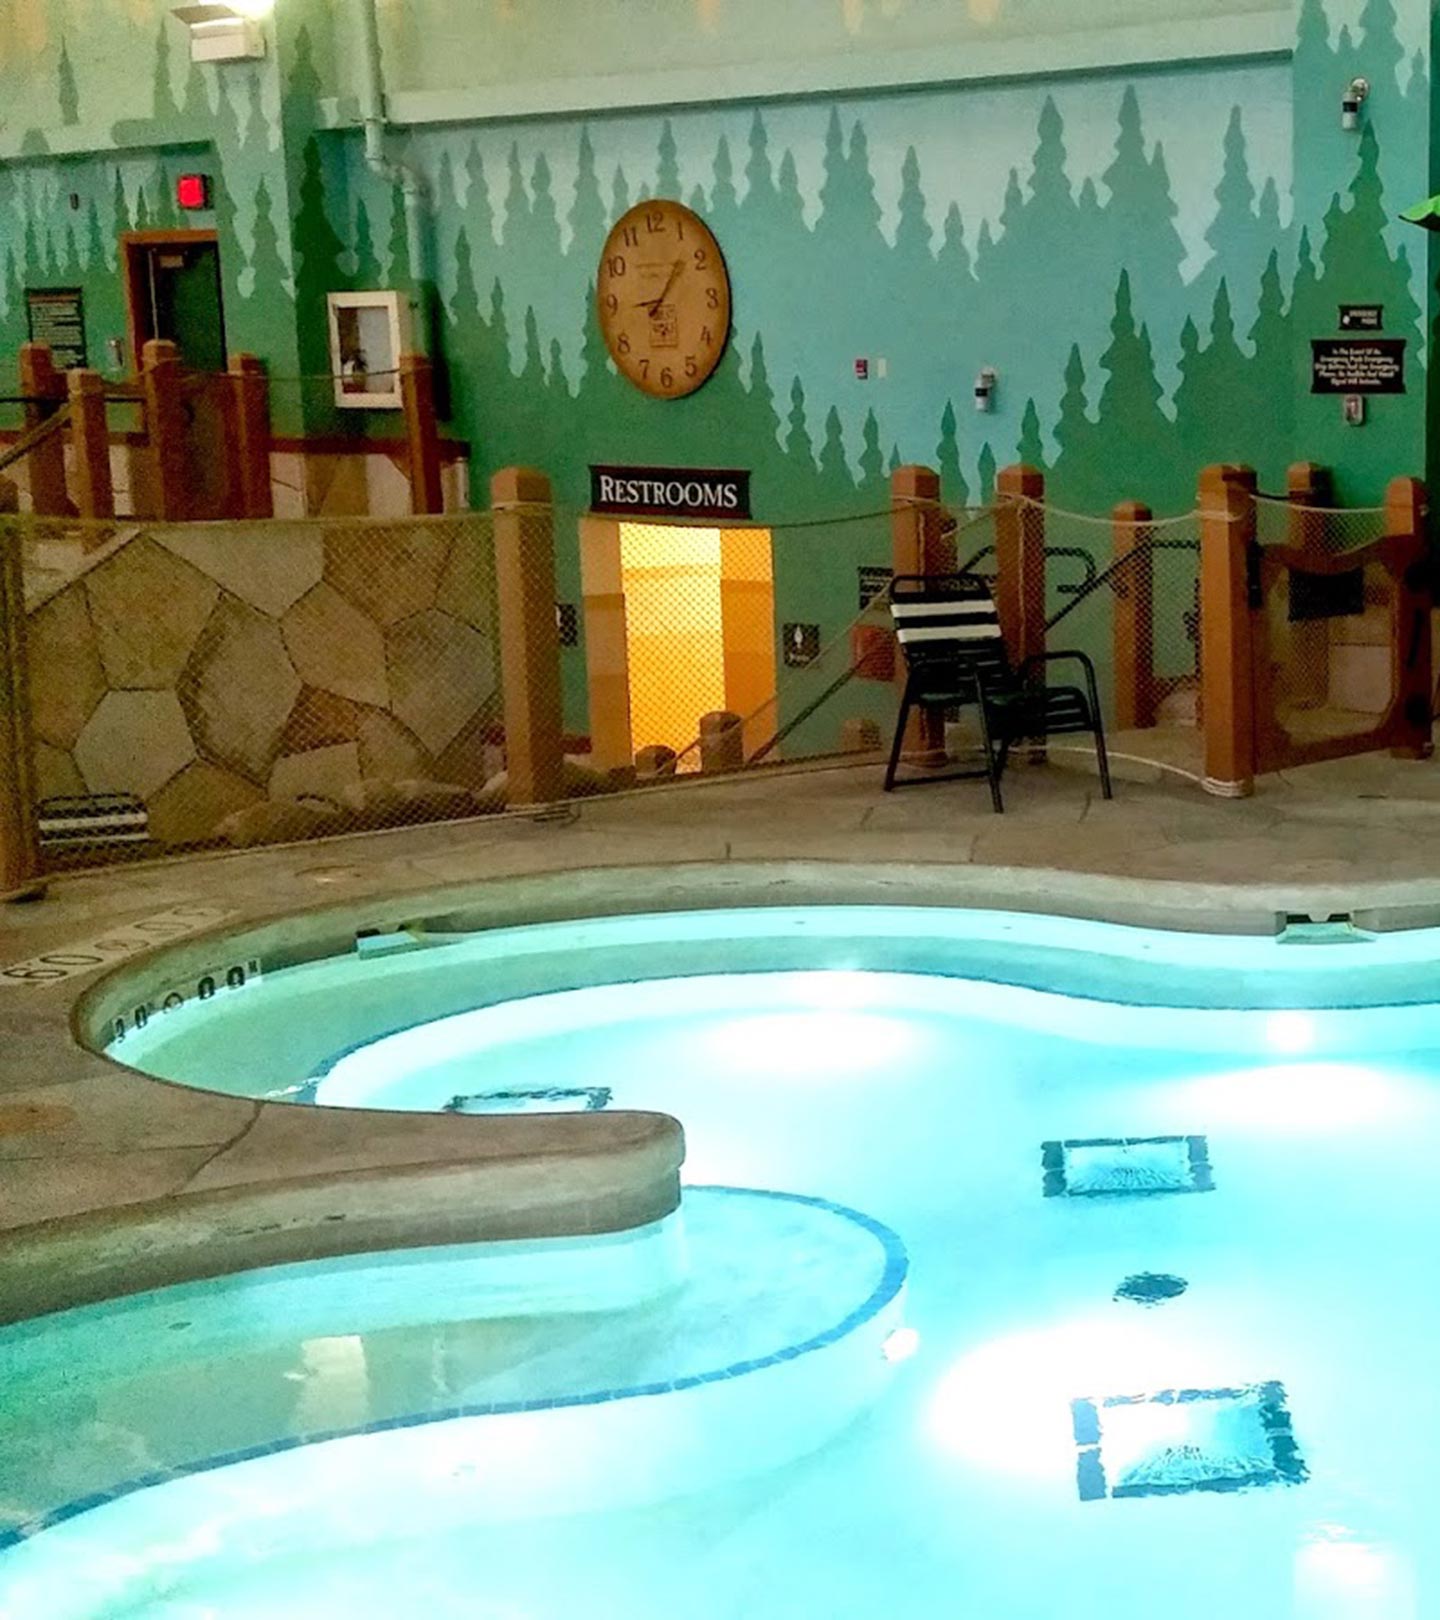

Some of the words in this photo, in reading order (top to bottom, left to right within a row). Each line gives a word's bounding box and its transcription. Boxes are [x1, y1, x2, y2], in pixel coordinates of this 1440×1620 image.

[645, 212, 667, 233] 12
[676, 222, 684, 241] 1
[622, 227, 639, 247] 11
[607, 255, 626, 278] 10
[694, 249, 707, 271] 2
[606, 294, 618, 316] 9
[706, 287, 719, 309] 3
[617, 332, 631, 354] 8
[700, 325, 713, 346] 4
[638, 359, 650, 380] 7
[685, 356, 698, 377] 5
[660, 367, 673, 389] 6
[600, 475, 738, 508] RESTROOMS
